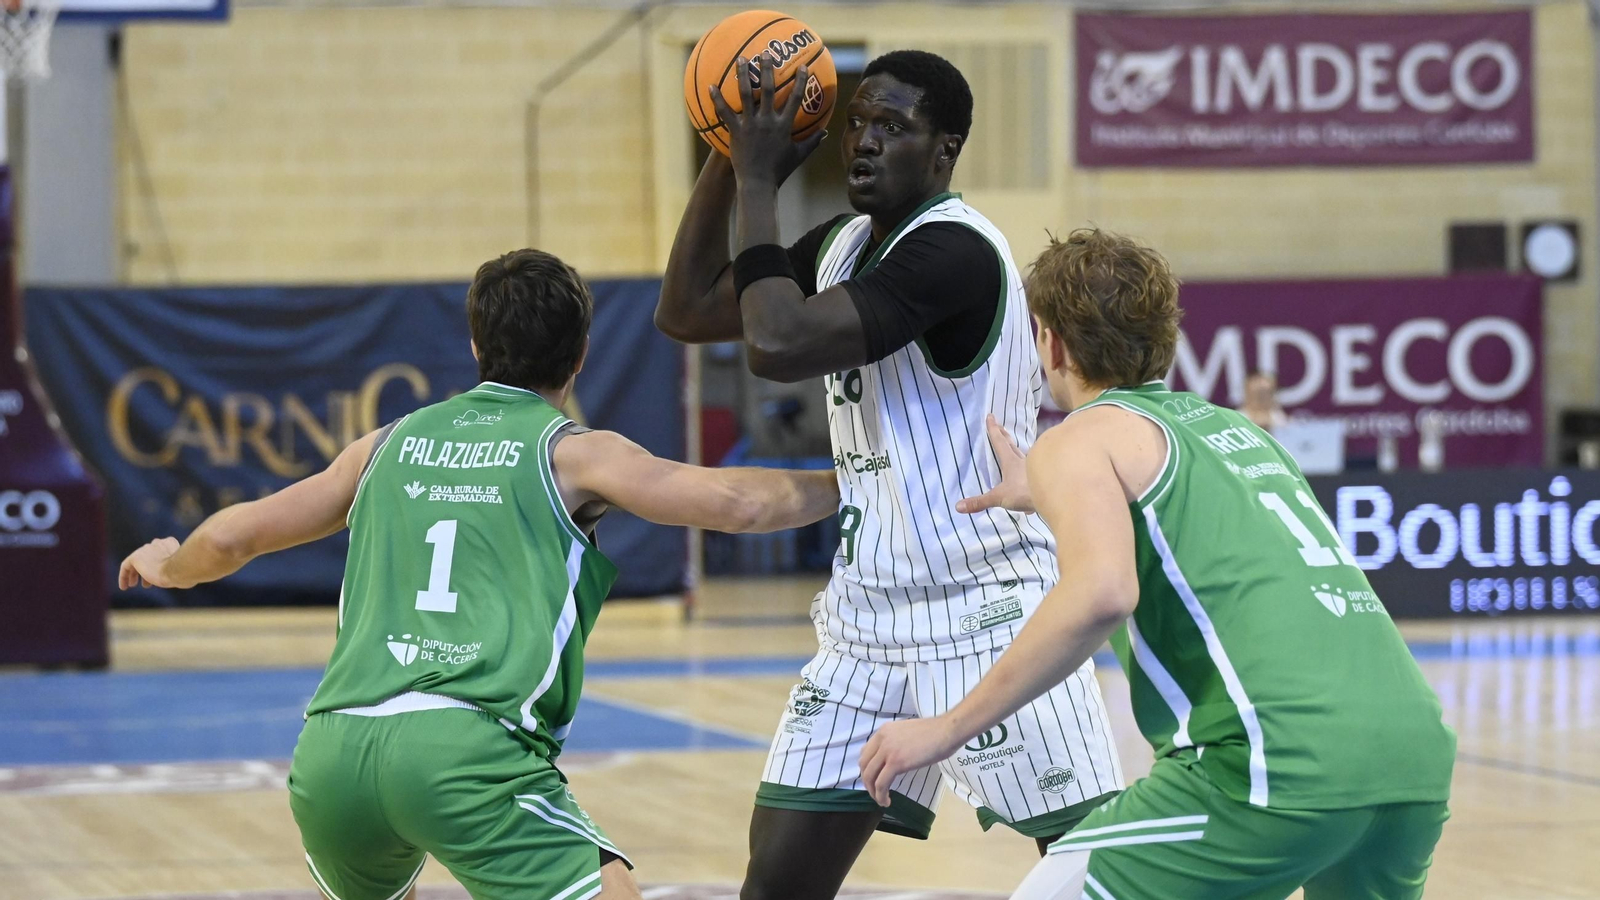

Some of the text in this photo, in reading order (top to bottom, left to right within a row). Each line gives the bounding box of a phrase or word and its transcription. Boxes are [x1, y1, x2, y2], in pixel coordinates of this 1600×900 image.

[1189, 38, 1520, 114] IMDECO
[1166, 316, 1534, 404] MDECO
[1200, 424, 1268, 455] RCÍA
[398, 436, 524, 469] PALAZUELOS
[430, 485, 499, 495] CAJA RURAL DE
[428, 493, 503, 504] EXTREMADURA
[415, 519, 458, 613] 1
[1347, 591, 1379, 601] DIPUTA
[1352, 602, 1365, 613] DE
[422, 639, 482, 654] DIPUTACIÓN
[420, 651, 478, 665] DE CÁCERES
[957, 744, 1024, 767] SohoBoutique
[979, 760, 1005, 772] HOTELS
